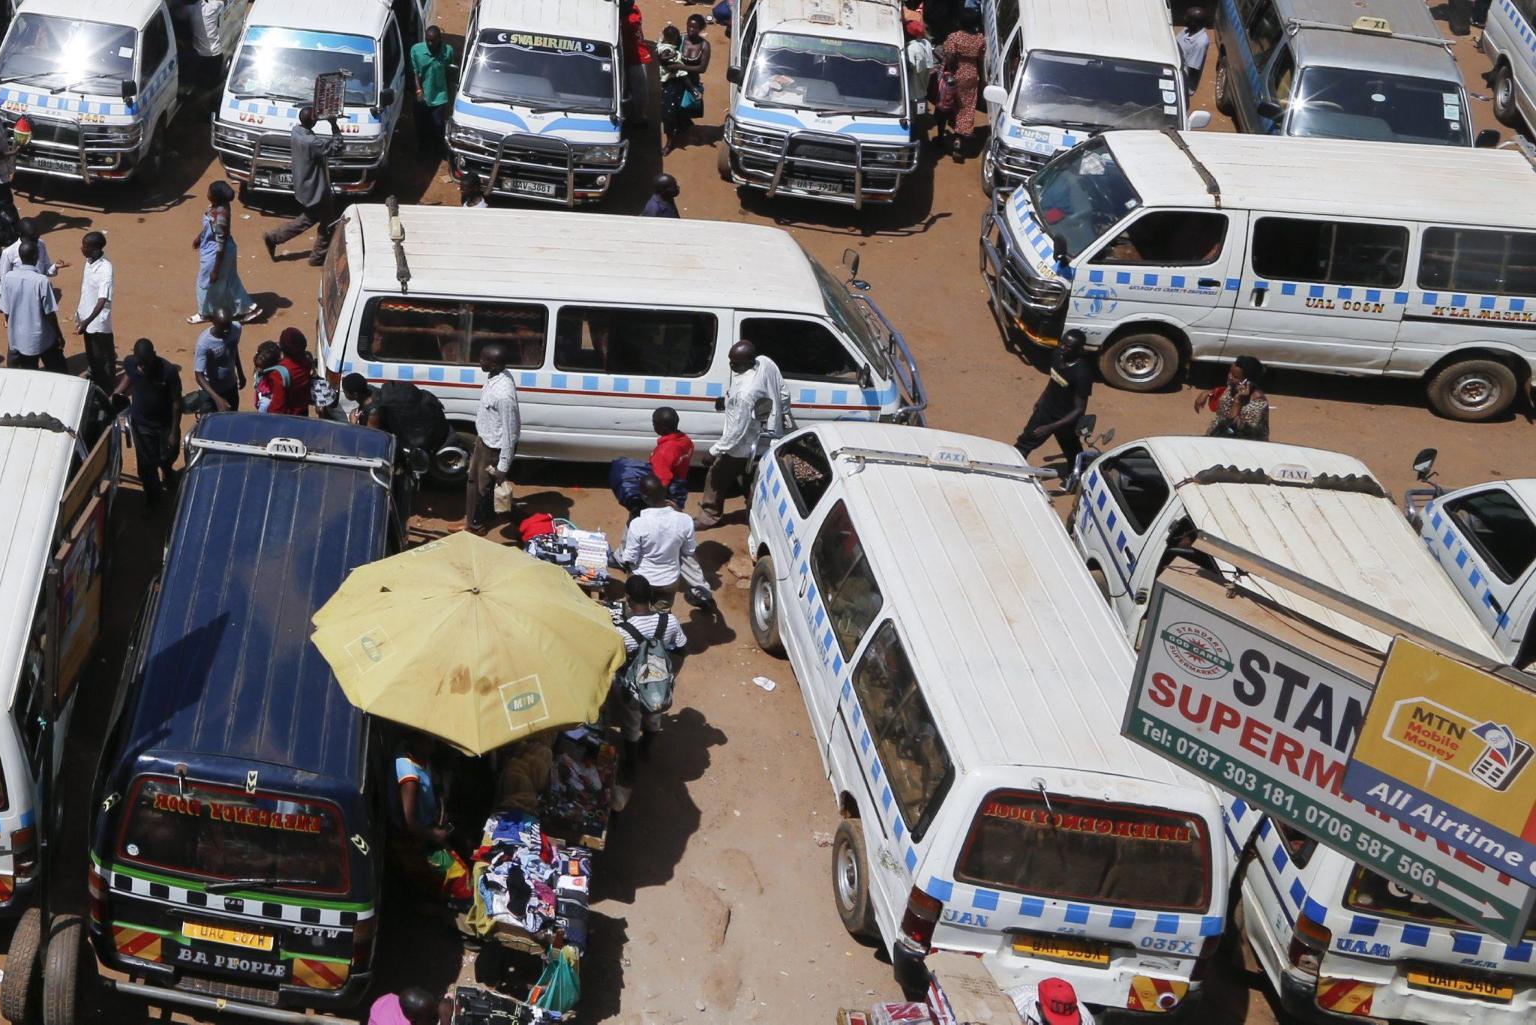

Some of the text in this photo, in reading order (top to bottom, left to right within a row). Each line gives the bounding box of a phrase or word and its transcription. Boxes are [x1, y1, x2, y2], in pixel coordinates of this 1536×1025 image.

[1021, 127, 1050, 140] turbo
[1305, 297, 1335, 310] UAL
[274, 443, 299, 454] TAXI
[1169, 635, 1226, 666] GOD CARES
[1176, 626, 1224, 653] STANDARD
[1169, 645, 1221, 676] SUPERMARKET
[513, 693, 535, 711] MTN
[1407, 720, 1461, 753] Mobile
[1411, 705, 1466, 741] MTN
[1403, 730, 1458, 761] Money
[1142, 717, 1437, 887] Tel: 0787 303 181, 0706 587 566
[1366, 782, 1524, 868] All Airtime
[942, 908, 989, 928] UAN
[293, 925, 340, 939] 587W
[1140, 936, 1194, 955] 035X
[1336, 937, 1392, 958] UAM
[177, 948, 287, 977] BA PEOPLE
